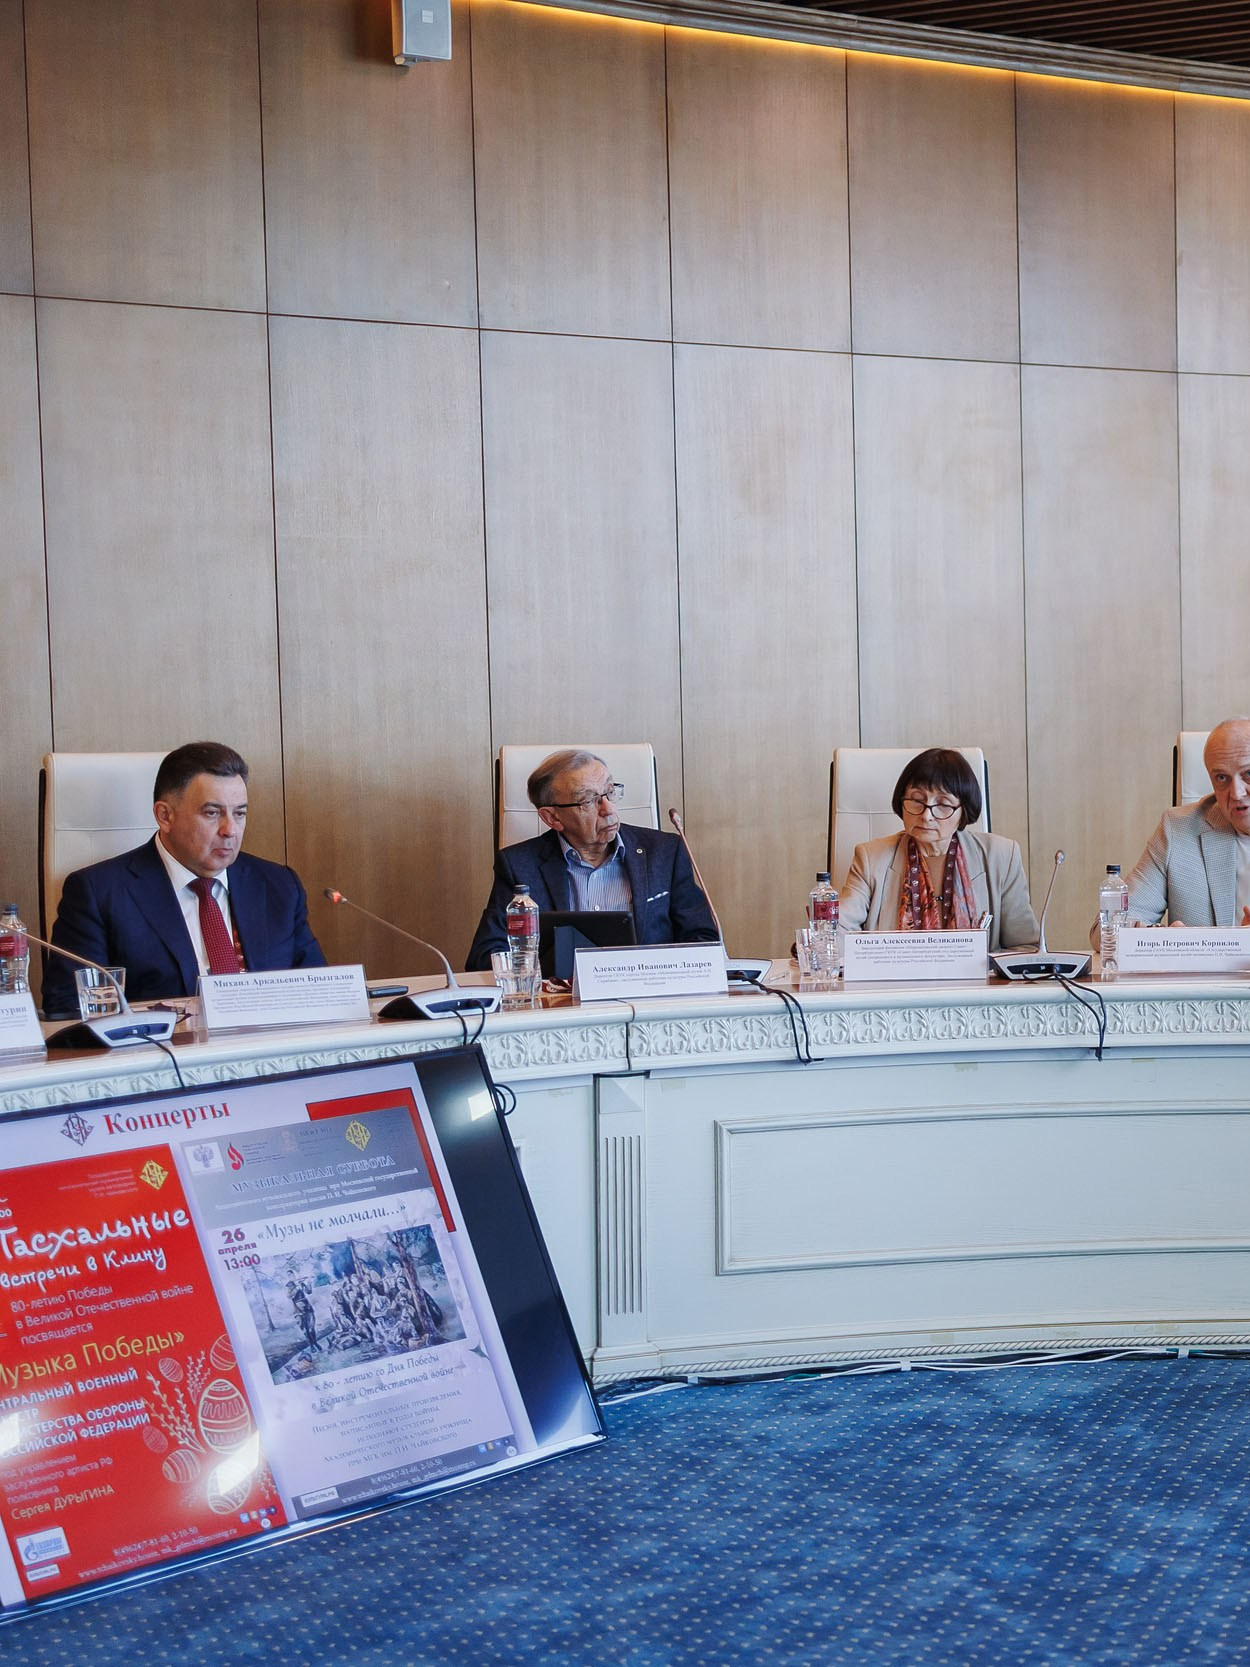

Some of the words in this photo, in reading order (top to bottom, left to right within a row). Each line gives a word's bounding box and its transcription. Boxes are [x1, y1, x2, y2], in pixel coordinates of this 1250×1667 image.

[1137, 940, 1160, 948] Игорь
[1162, 940, 1200, 948] Петрович
[637, 963, 678, 971] Иванович
[213, 979, 250, 989] Михаил
[103, 1102, 231, 1136] Концерты
[221, 1227, 246, 1245] 26
[309, 1219, 324, 1232] не
[217, 1241, 258, 1257] апреля
[0, 1263, 80, 1293] встречи
[86, 1255, 97, 1271] в
[103, 1246, 167, 1272] Клину
[223, 1252, 262, 1272] 13:00
[10, 1293, 66, 1313] 80-летию
[67, 1284, 113, 1301] Победы
[15, 1319, 23, 1330] в
[25, 1307, 73, 1327] Великой
[75, 1290, 159, 1317] Отечественной
[162, 1283, 194, 1298] войне
[20, 1321, 94, 1346] посвящается
[82, 1330, 186, 1367] Победы»
[406, 1352, 440, 1370] Победы
[77, 1367, 139, 1393] ВОЕННЫЙ
[86, 1398, 147, 1421] ОБОРОНЫ
[0, 1429, 78, 1459] ОССИЙСКОЙ
[79, 1412, 151, 1438] ФЕДЕРАЦИИ
[11, 1501, 51, 1520] Сергея
[54, 1484, 115, 1511] ДУРЫГИНА
